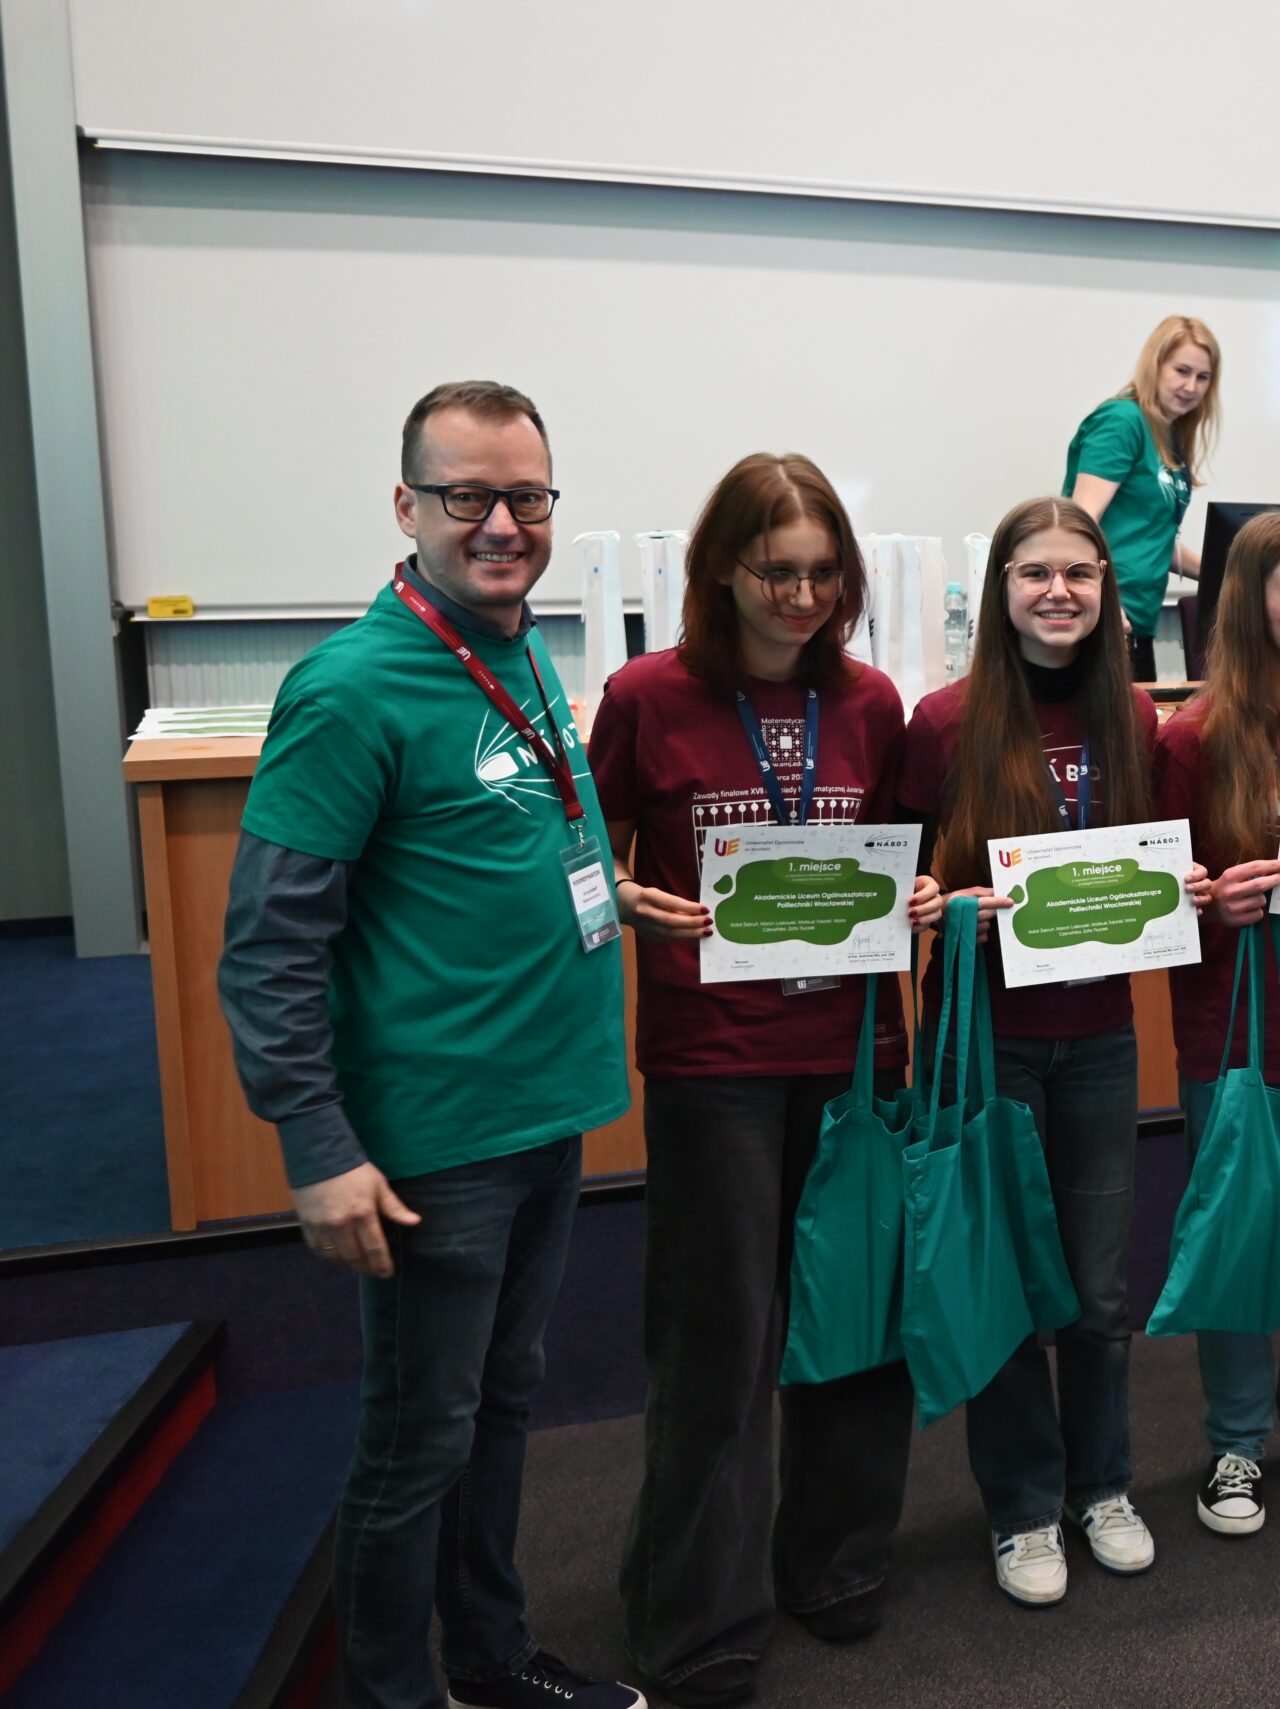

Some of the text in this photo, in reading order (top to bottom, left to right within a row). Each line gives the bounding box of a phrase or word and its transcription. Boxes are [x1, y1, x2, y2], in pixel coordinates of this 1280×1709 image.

[693, 791, 719, 800] Zawody
[714, 837, 741, 857] UE
[998, 847, 1023, 868] UE
[788, 861, 841, 873] 1. miejsce
[1072, 864, 1122, 877] 1. miejsce
[754, 892, 796, 901] Akademickie
[1046, 897, 1086, 908] Akademickie
[1086, 895, 1108, 904] Liceum
[777, 901, 813, 909] Politechniki
[1069, 904, 1103, 913] Politechniki
